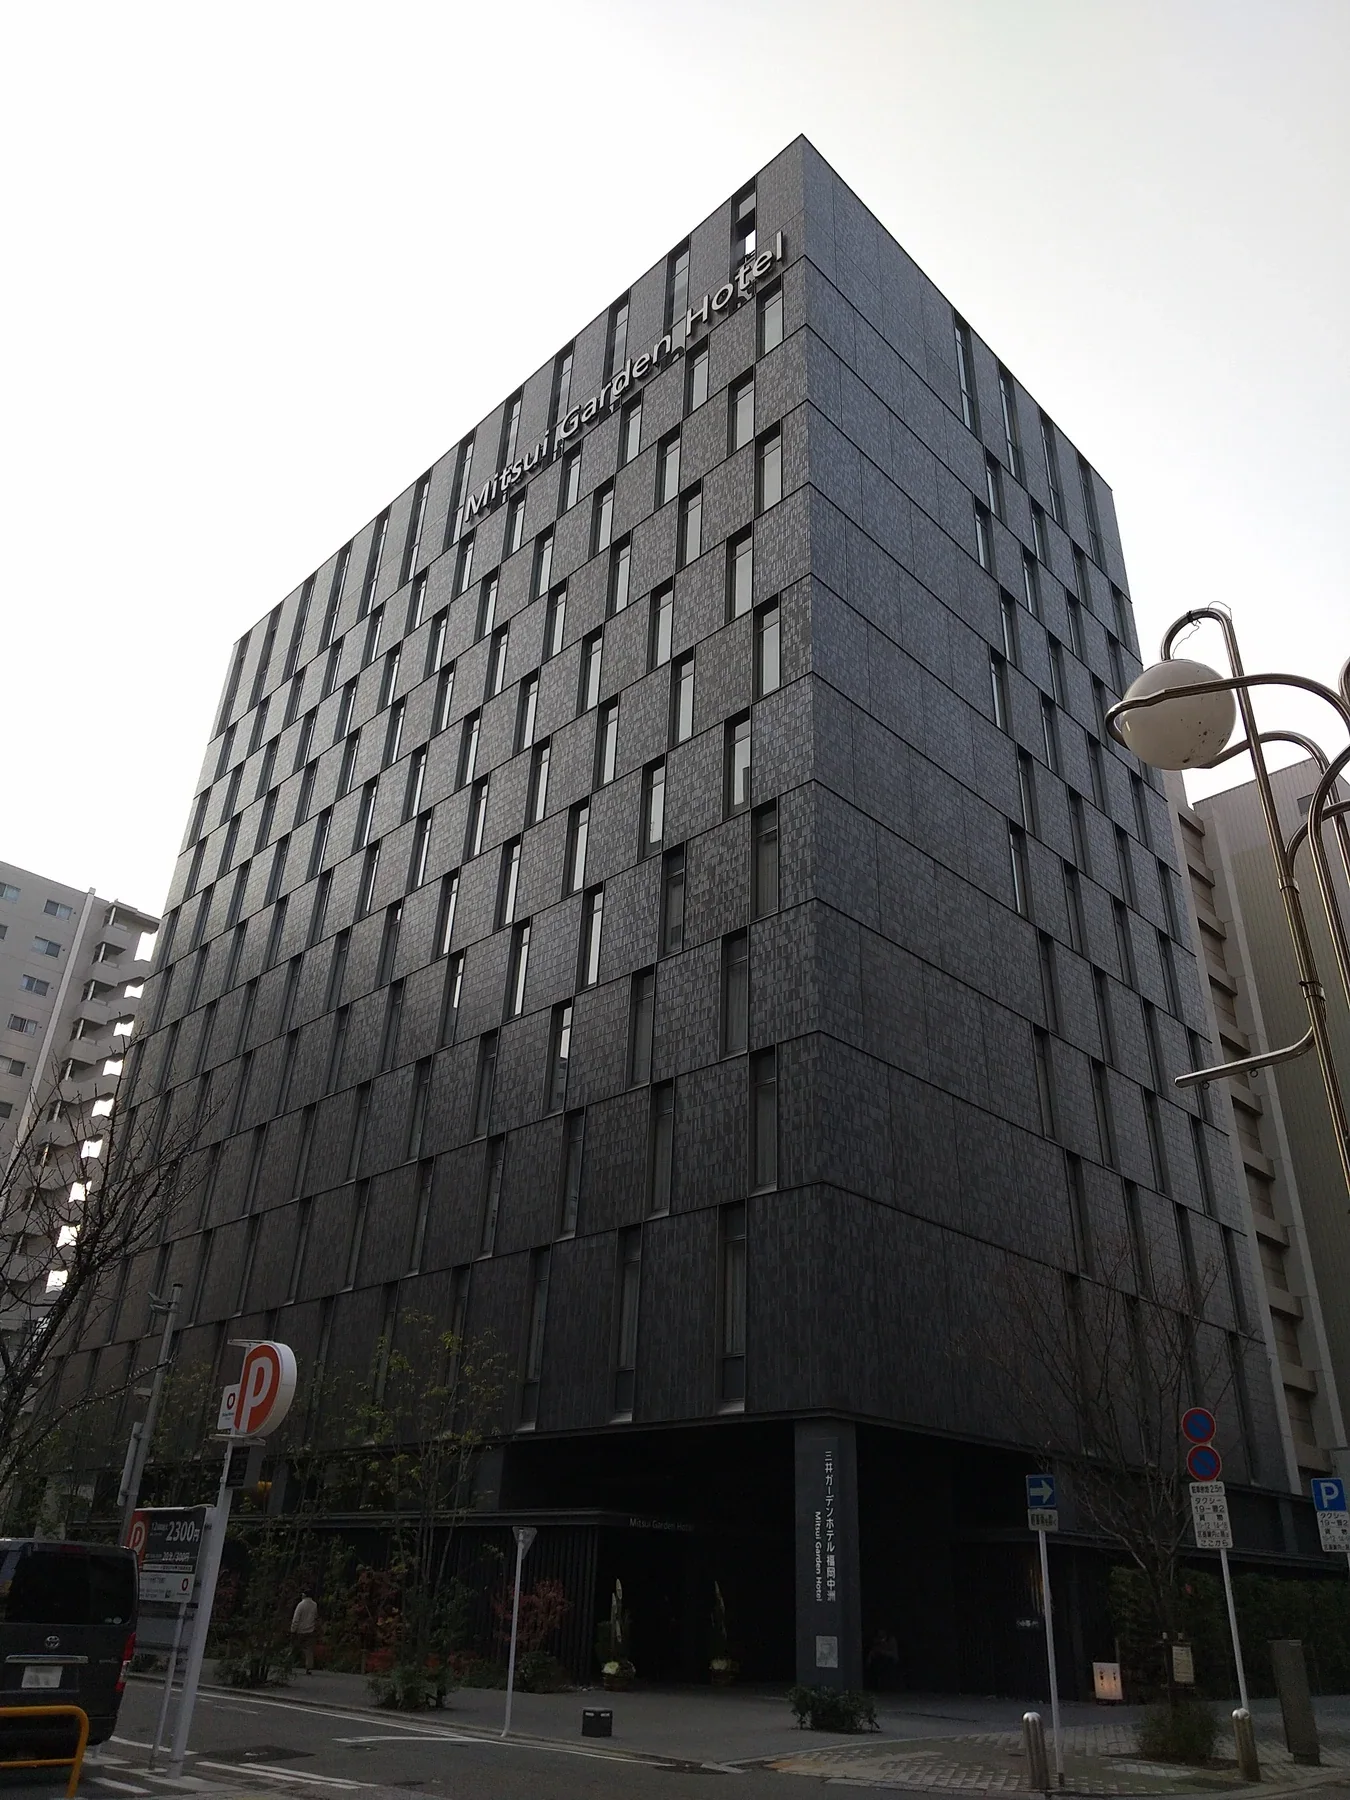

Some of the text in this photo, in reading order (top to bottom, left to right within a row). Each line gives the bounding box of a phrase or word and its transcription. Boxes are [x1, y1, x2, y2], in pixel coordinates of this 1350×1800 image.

[464, 230, 784, 523] Mitsui Garden Hotel
[239, 1356, 273, 1433] P
[825, 1451, 835, 1552] 三井ガーデンホテル
[1194, 1497, 1222, 1505] タクシー
[1320, 1482, 1339, 1508] P
[165, 1520, 201, 1543] 2300円
[629, 1517, 652, 1529] Mitsui
[652, 1519, 676, 1531] Garden
